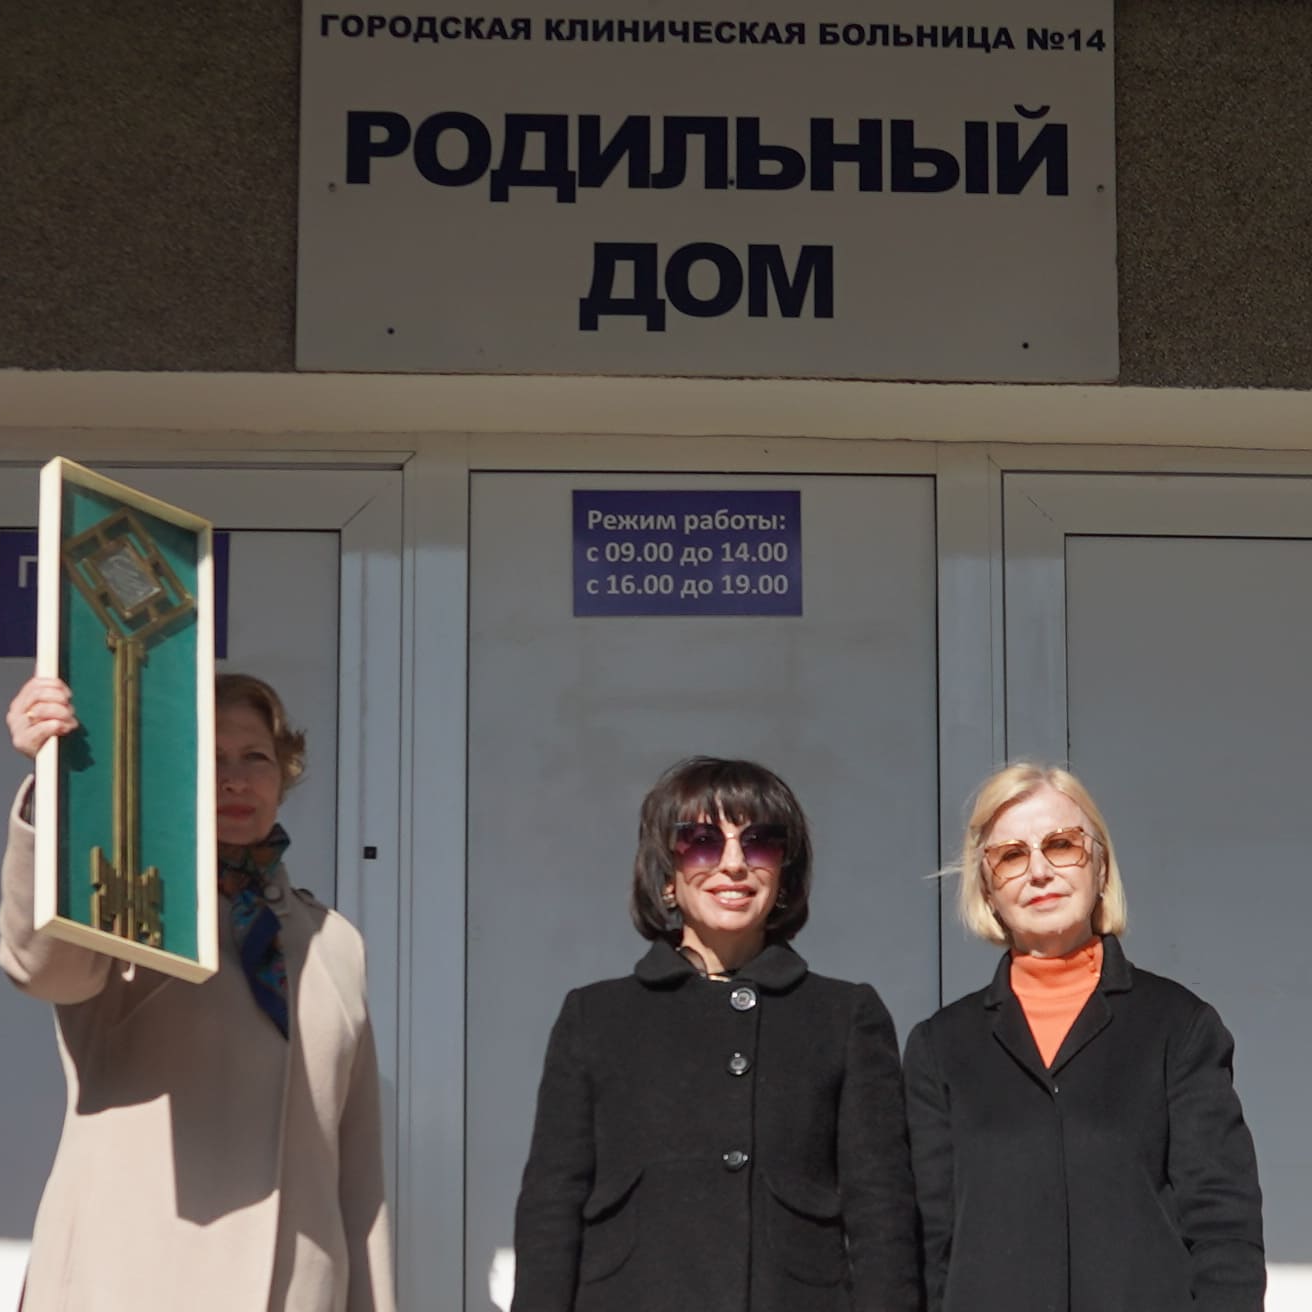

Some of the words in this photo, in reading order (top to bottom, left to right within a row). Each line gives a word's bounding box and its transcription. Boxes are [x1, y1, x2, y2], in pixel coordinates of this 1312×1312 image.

[320, 14, 531, 43] ГОРОДСКАЯ
[545, 18, 806, 45] КЛИНИЧЕСКАЯ
[819, 23, 1015, 53] БОЛЬНИЦА
[1026, 28, 1106, 52] №14
[345, 103, 1069, 203] РОДИЛЬНЫЙ
[579, 241, 835, 332] ДОМ
[588, 510, 677, 531] Режим
[684, 509, 786, 535] работы:
[586, 546, 599, 562] с
[605, 542, 673, 562] 09.00
[680, 546, 713, 566] до
[720, 542, 788, 562] 14.00
[586, 578, 599, 594] с
[606, 574, 674, 595] 16.00
[680, 578, 713, 598] до
[721, 574, 788, 595] 19.00
